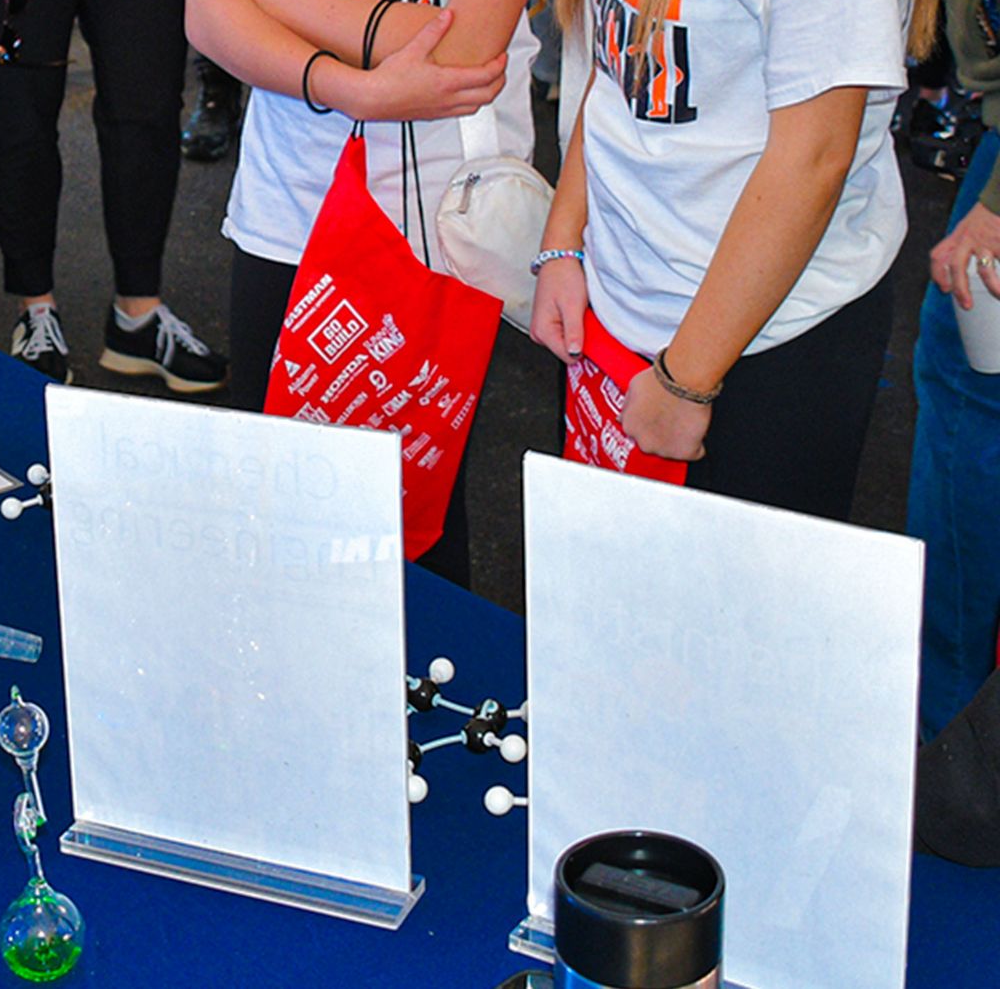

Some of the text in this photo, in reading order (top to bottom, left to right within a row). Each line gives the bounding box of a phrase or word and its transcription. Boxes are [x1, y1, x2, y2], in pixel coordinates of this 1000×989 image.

[322, 319, 341, 340] GO
[324, 320, 360, 356] BUILD
[370, 329, 406, 362] KING
[320, 354, 369, 404] HONDA
